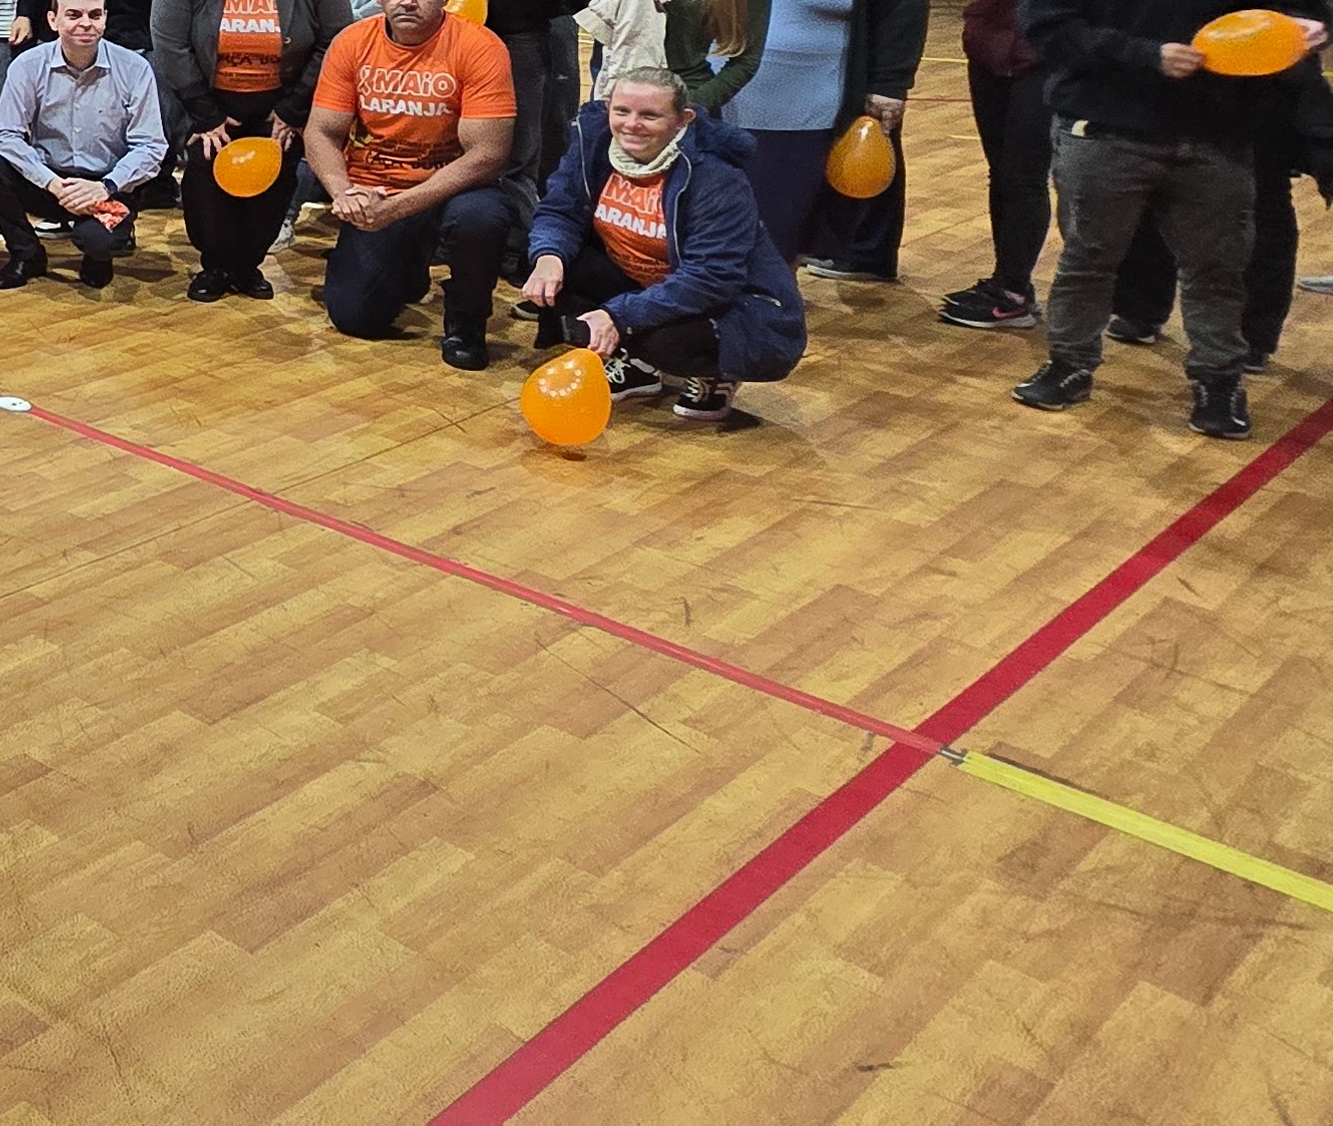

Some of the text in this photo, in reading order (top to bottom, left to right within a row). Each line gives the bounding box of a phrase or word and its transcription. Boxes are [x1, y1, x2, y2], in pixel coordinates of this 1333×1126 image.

[219, 18, 281, 33] ARAN
[360, 94, 453, 116] LARANJA
[594, 204, 667, 239] ARANJA
